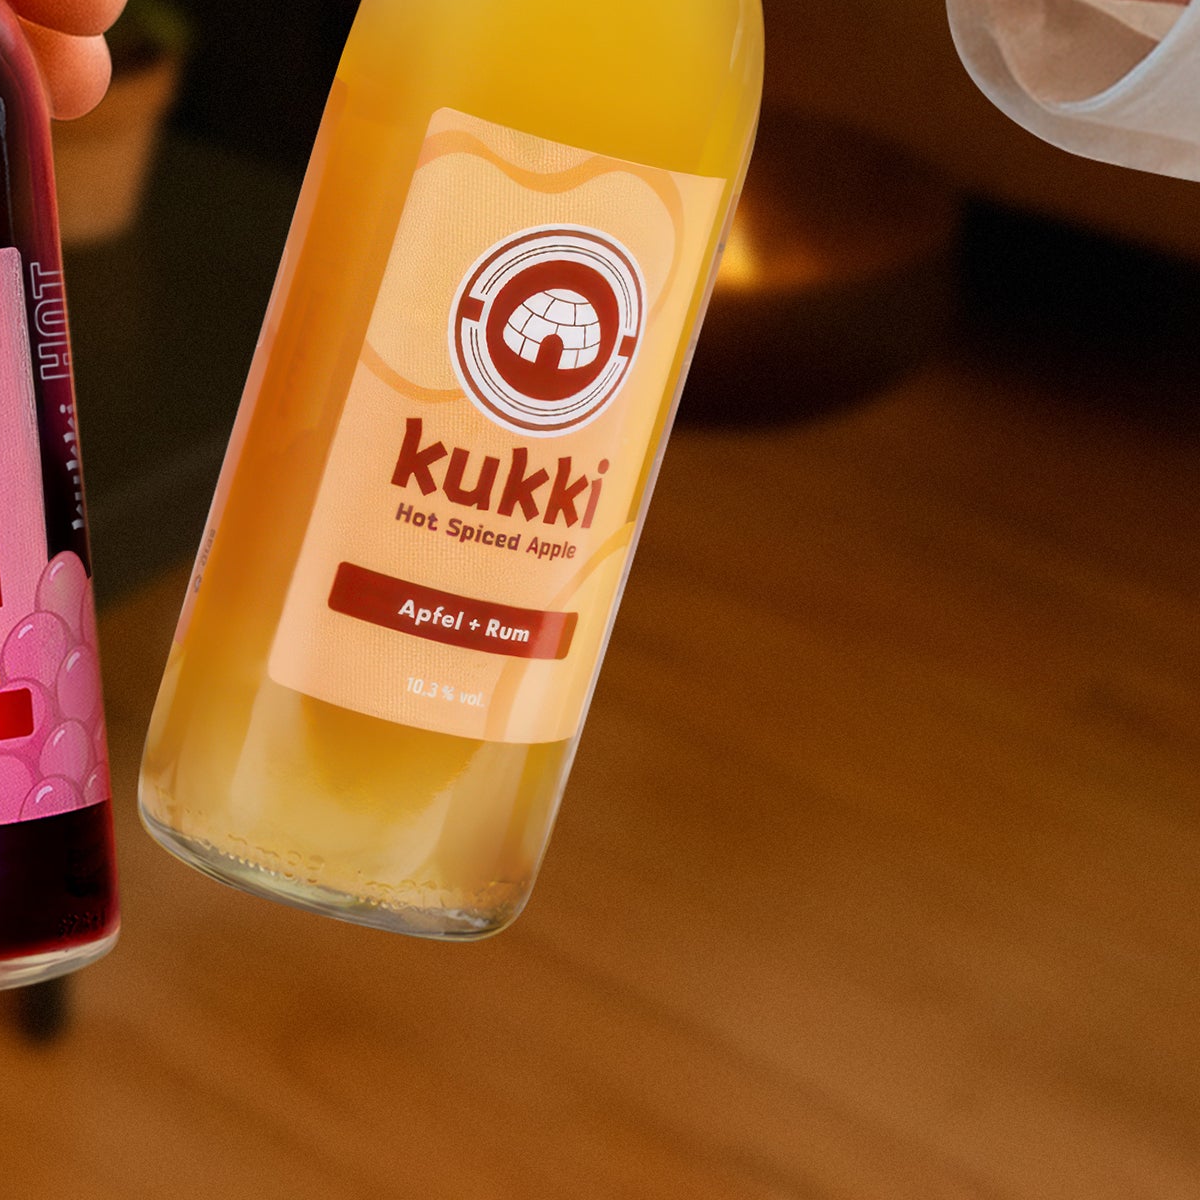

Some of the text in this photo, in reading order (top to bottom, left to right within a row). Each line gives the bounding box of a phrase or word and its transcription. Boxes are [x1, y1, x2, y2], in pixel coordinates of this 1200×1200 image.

[390, 417, 610, 529] kukki
[395, 502, 577, 561] Hot Spiced Apple
[398, 599, 465, 630] Apfel
[485, 618, 530, 642] Rum
